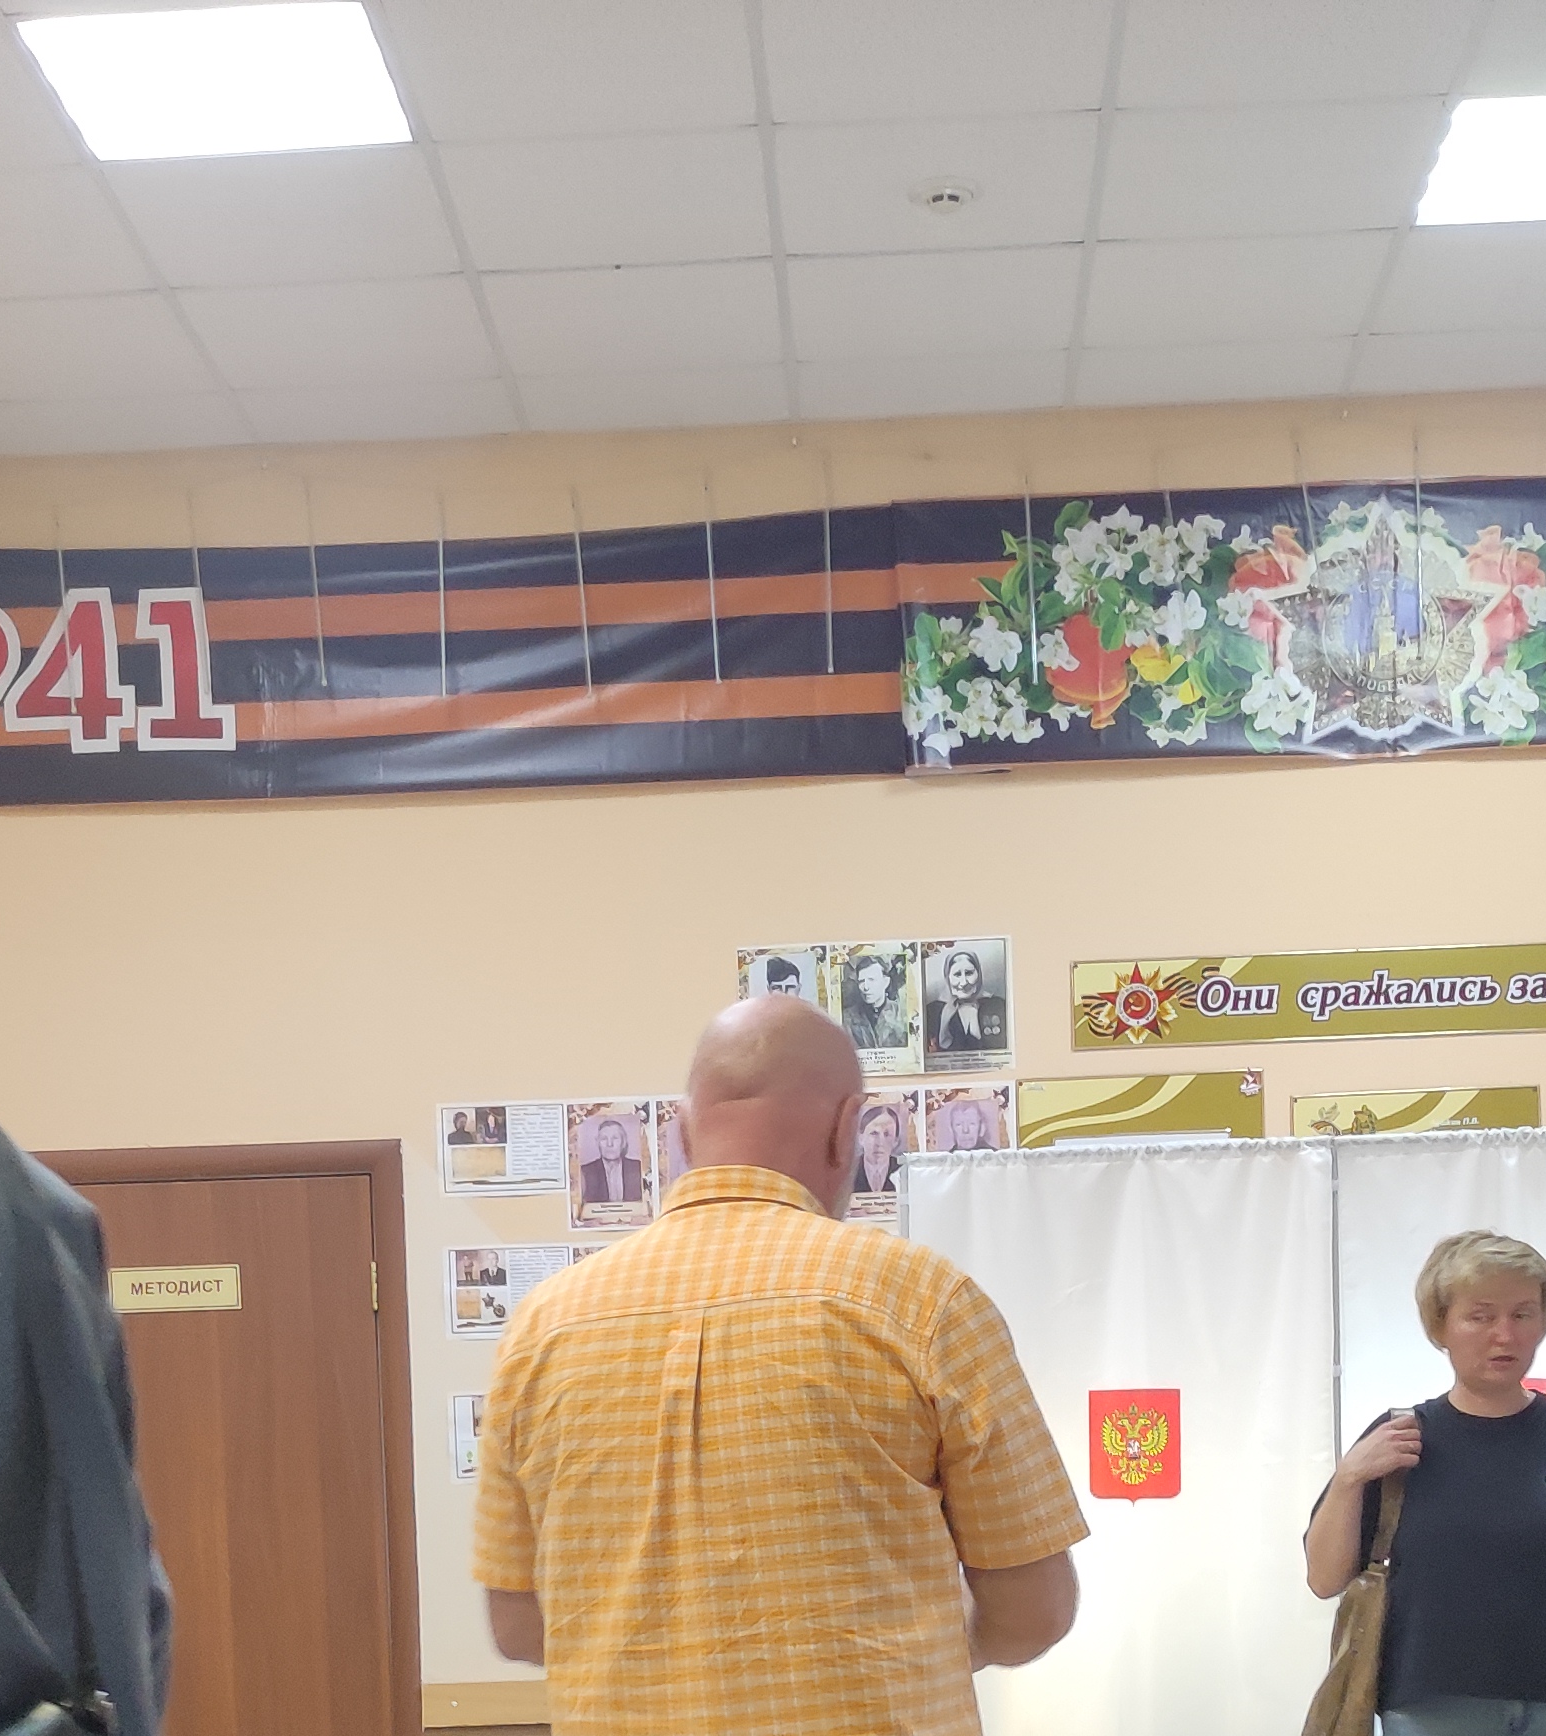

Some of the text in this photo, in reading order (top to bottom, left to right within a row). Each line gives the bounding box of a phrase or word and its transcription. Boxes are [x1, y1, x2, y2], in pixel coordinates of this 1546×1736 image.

[1196, 976, 1279, 1017] Они
[1297, 970, 1500, 1021] сражались
[131, 1279, 223, 1296] МЕТОДИСТ
